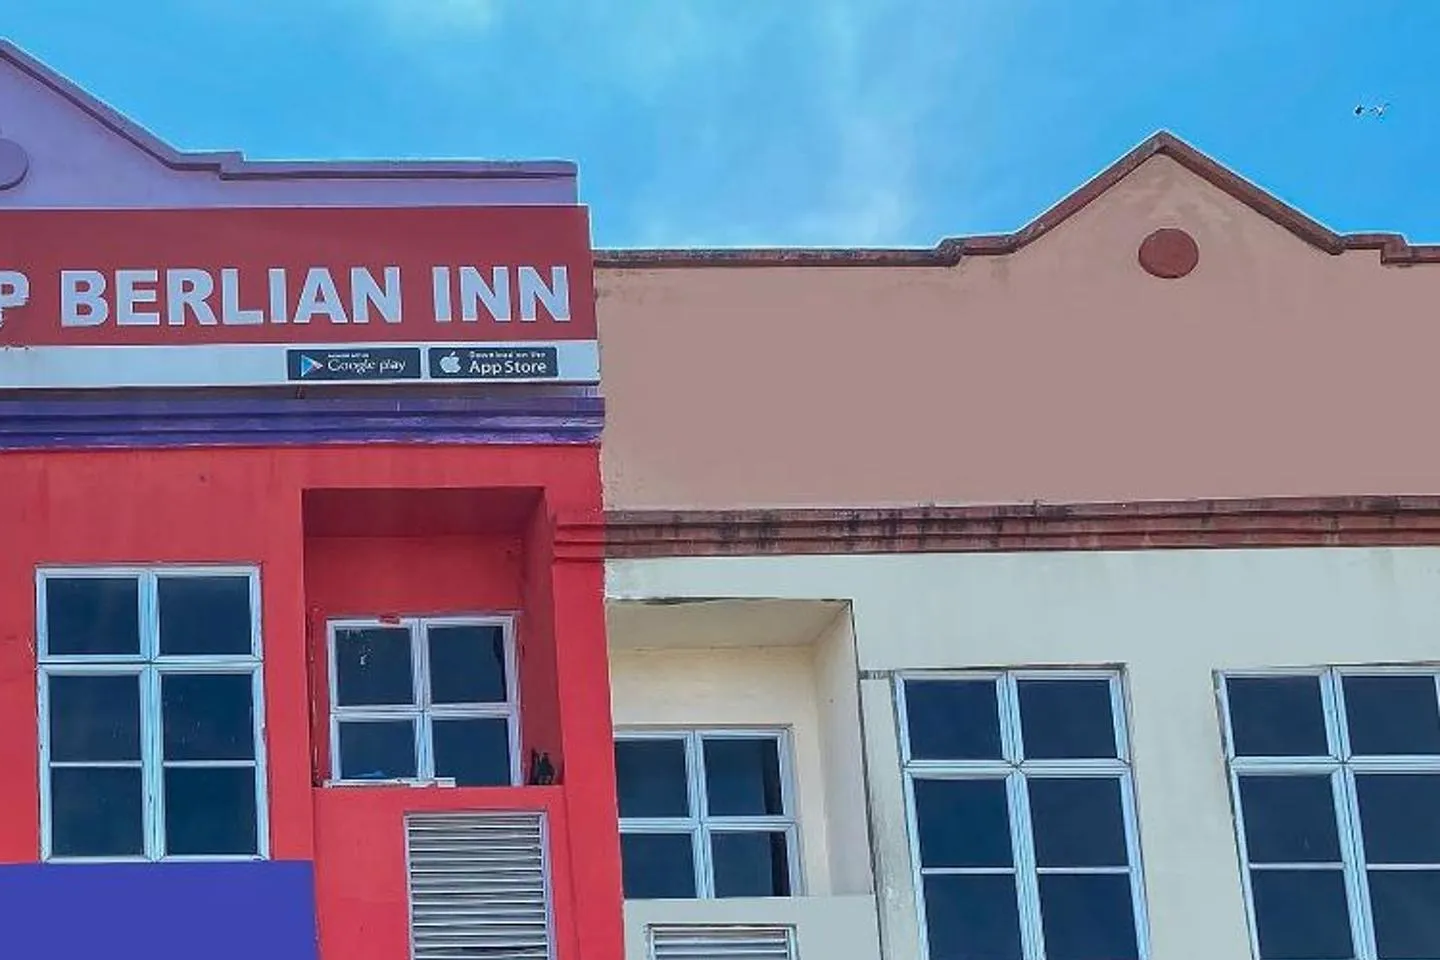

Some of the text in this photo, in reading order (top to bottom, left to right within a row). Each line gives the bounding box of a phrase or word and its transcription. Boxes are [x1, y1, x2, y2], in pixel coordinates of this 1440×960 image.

[61, 267, 402, 326] BERLIAN
[431, 266, 571, 322] INN
[380, 359, 406, 373] play
[469, 361, 547, 375] App Store
